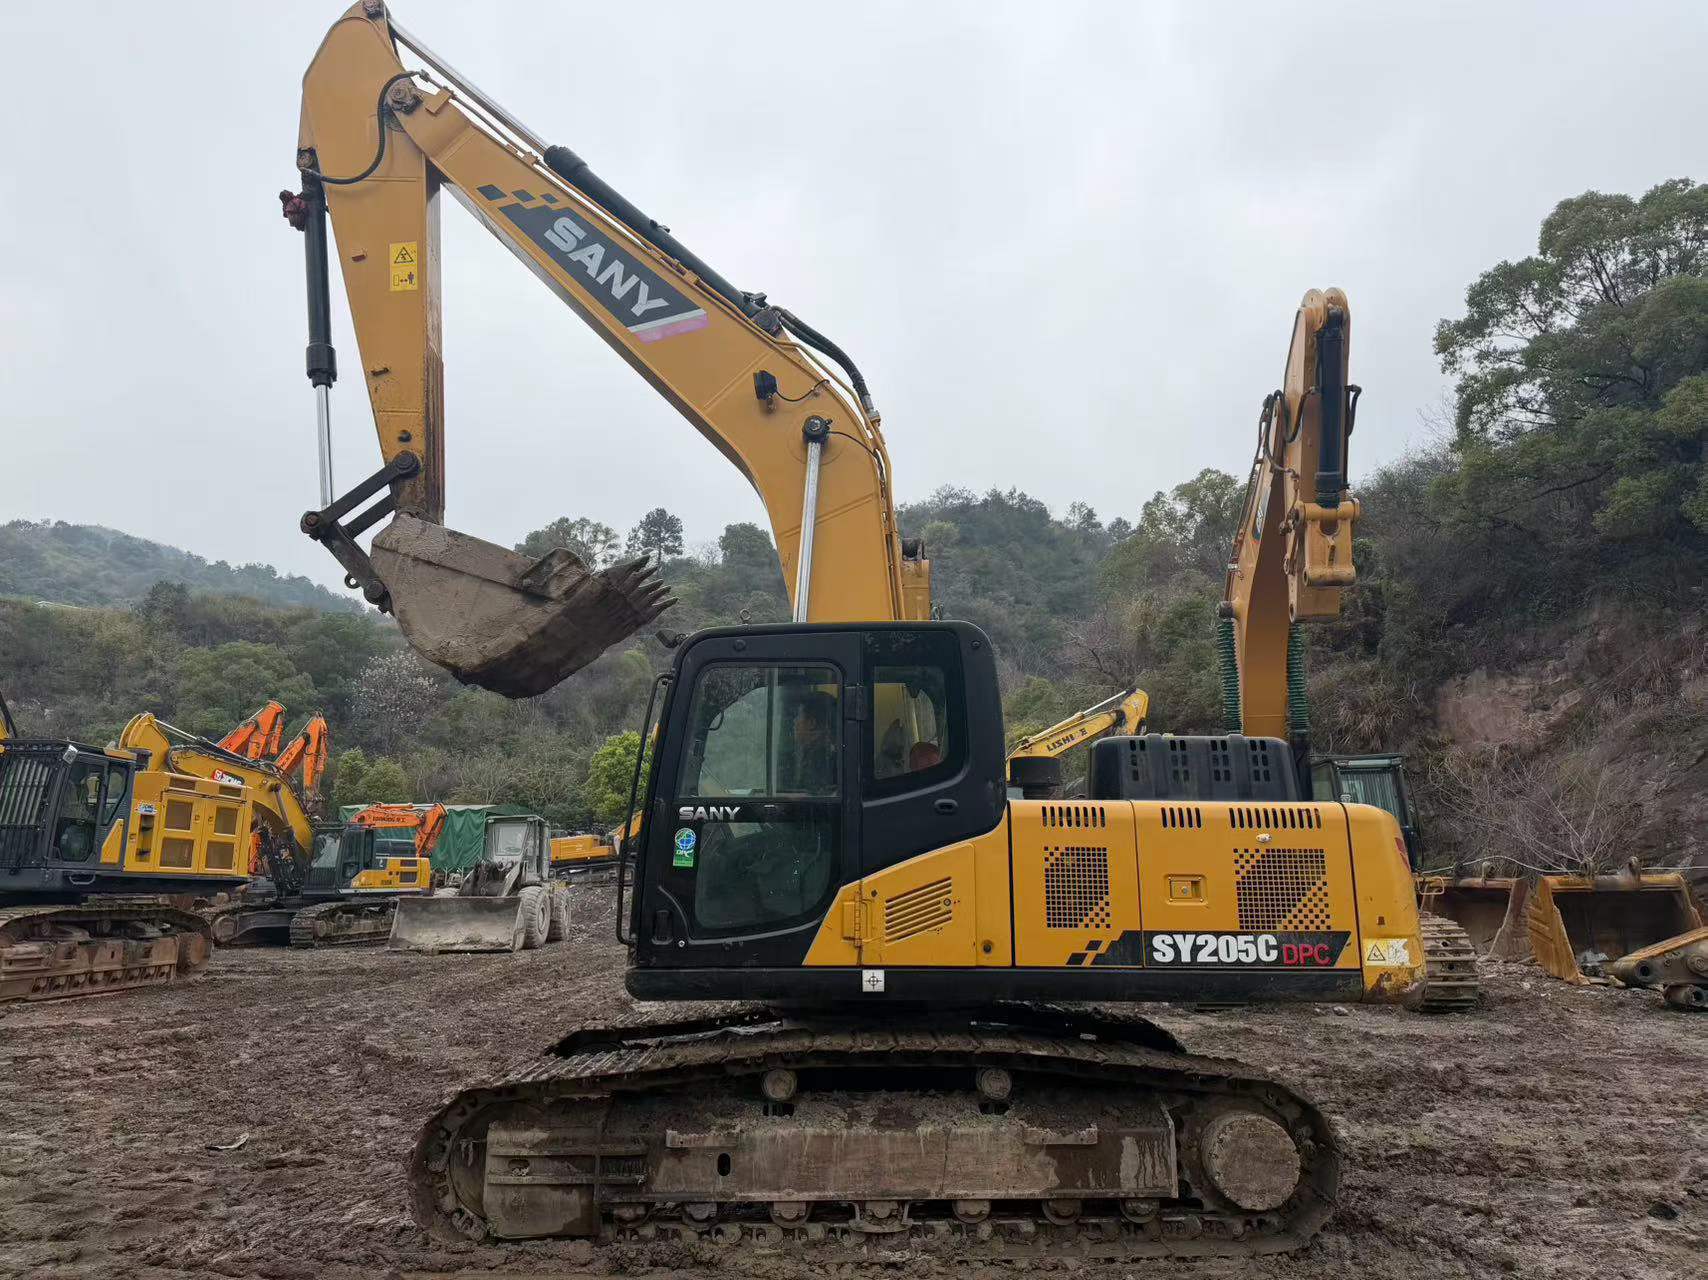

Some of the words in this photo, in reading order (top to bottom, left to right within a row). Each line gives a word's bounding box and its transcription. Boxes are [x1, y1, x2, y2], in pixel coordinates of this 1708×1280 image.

[544, 217, 669, 317] SANY
[679, 806, 741, 820] SANY
[1152, 933, 1278, 964] SY205C
[1282, 943, 1332, 966] DPC
